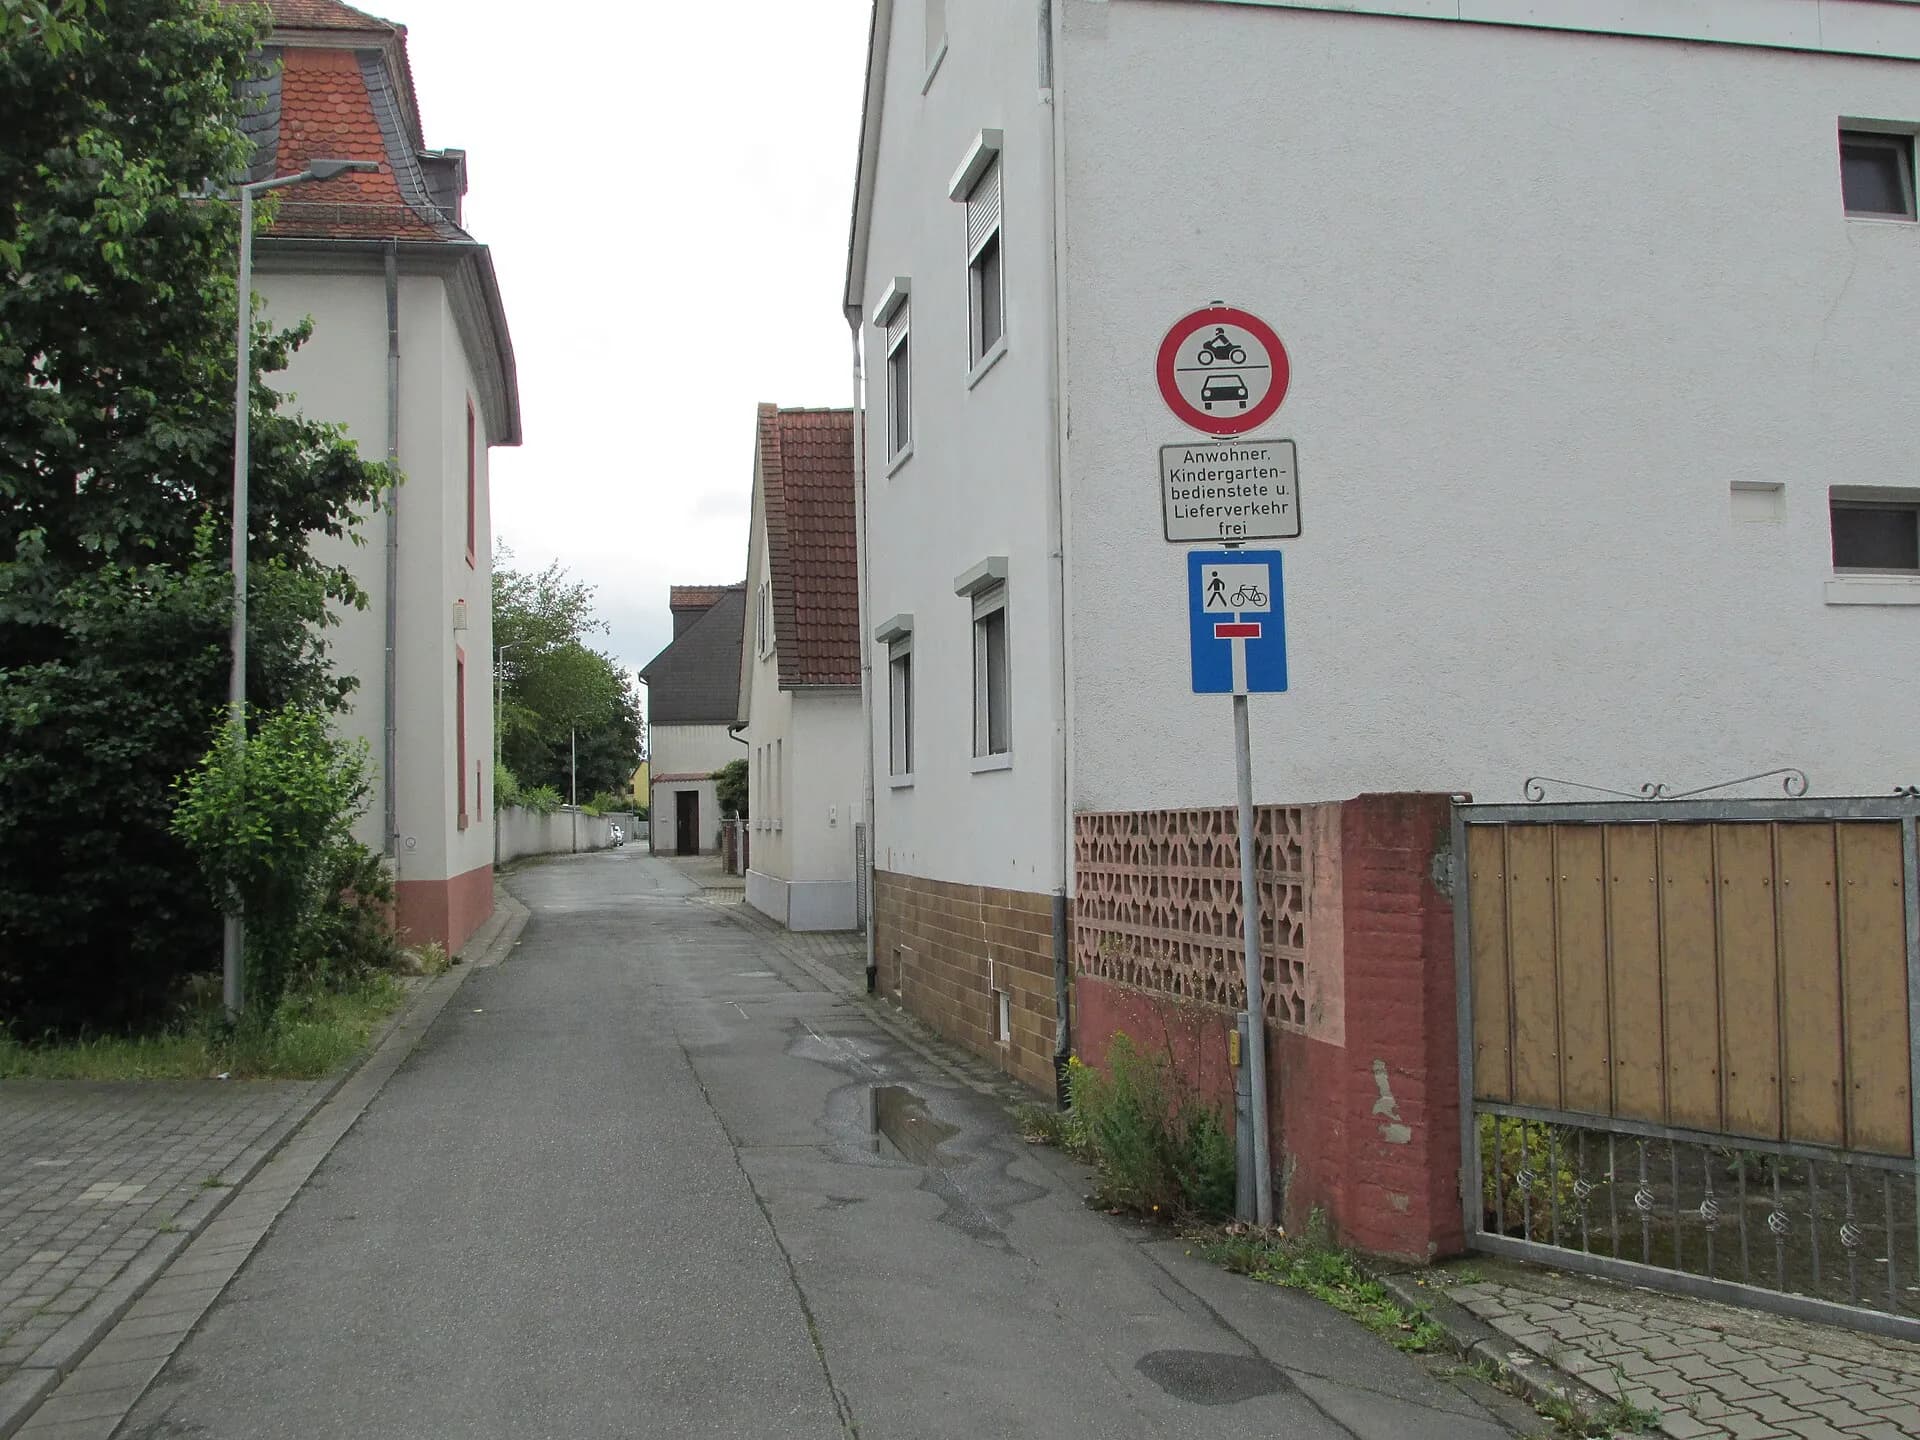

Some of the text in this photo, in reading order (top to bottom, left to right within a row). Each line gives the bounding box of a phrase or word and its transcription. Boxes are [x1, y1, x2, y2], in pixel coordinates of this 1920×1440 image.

[1170, 466, 1287, 483] Kindergarten-
[1171, 484, 1289, 500] bedienstete u.
[1174, 501, 1288, 519] Lieferverkehr
[1219, 521, 1247, 535] frei
